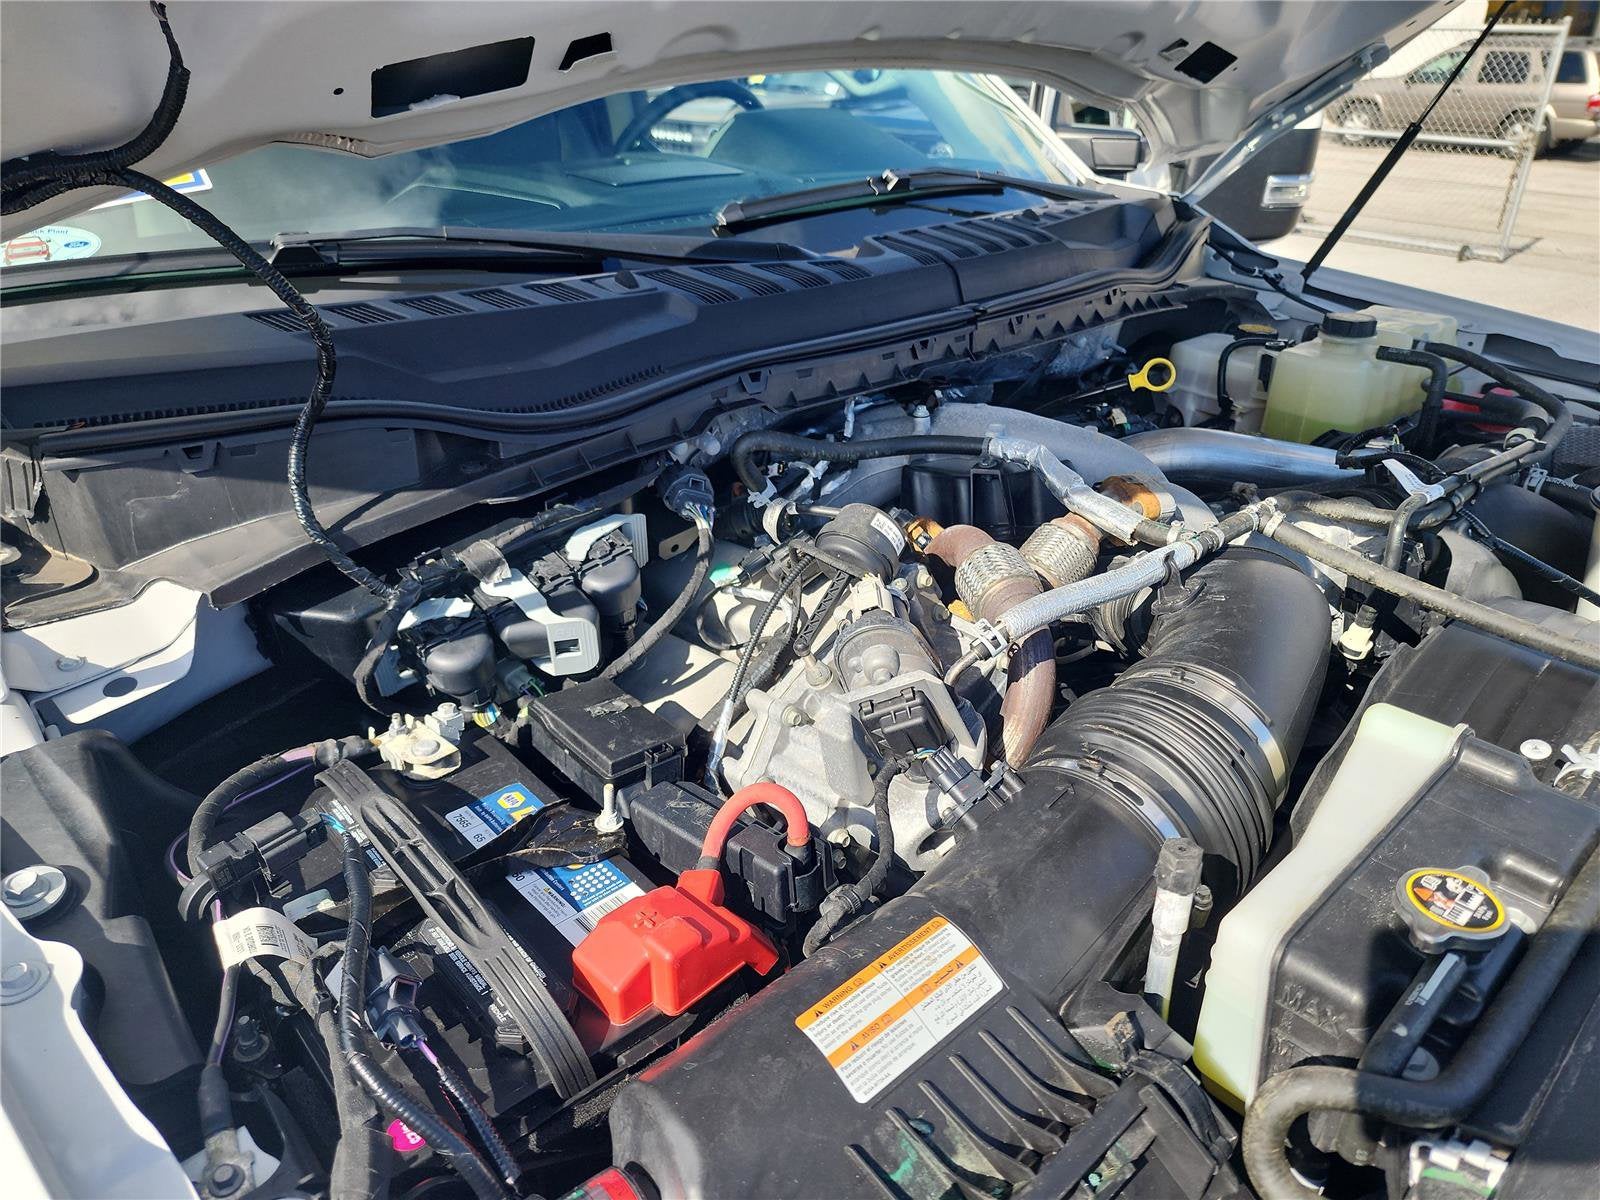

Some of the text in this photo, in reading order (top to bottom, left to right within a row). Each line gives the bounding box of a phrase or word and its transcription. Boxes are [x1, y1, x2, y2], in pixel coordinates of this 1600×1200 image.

[453, 813, 472, 828] 7565
[473, 833, 486, 843] 65
[887, 926, 932, 960] AVERTISSEMENT
[822, 984, 853, 1009] WARNING
